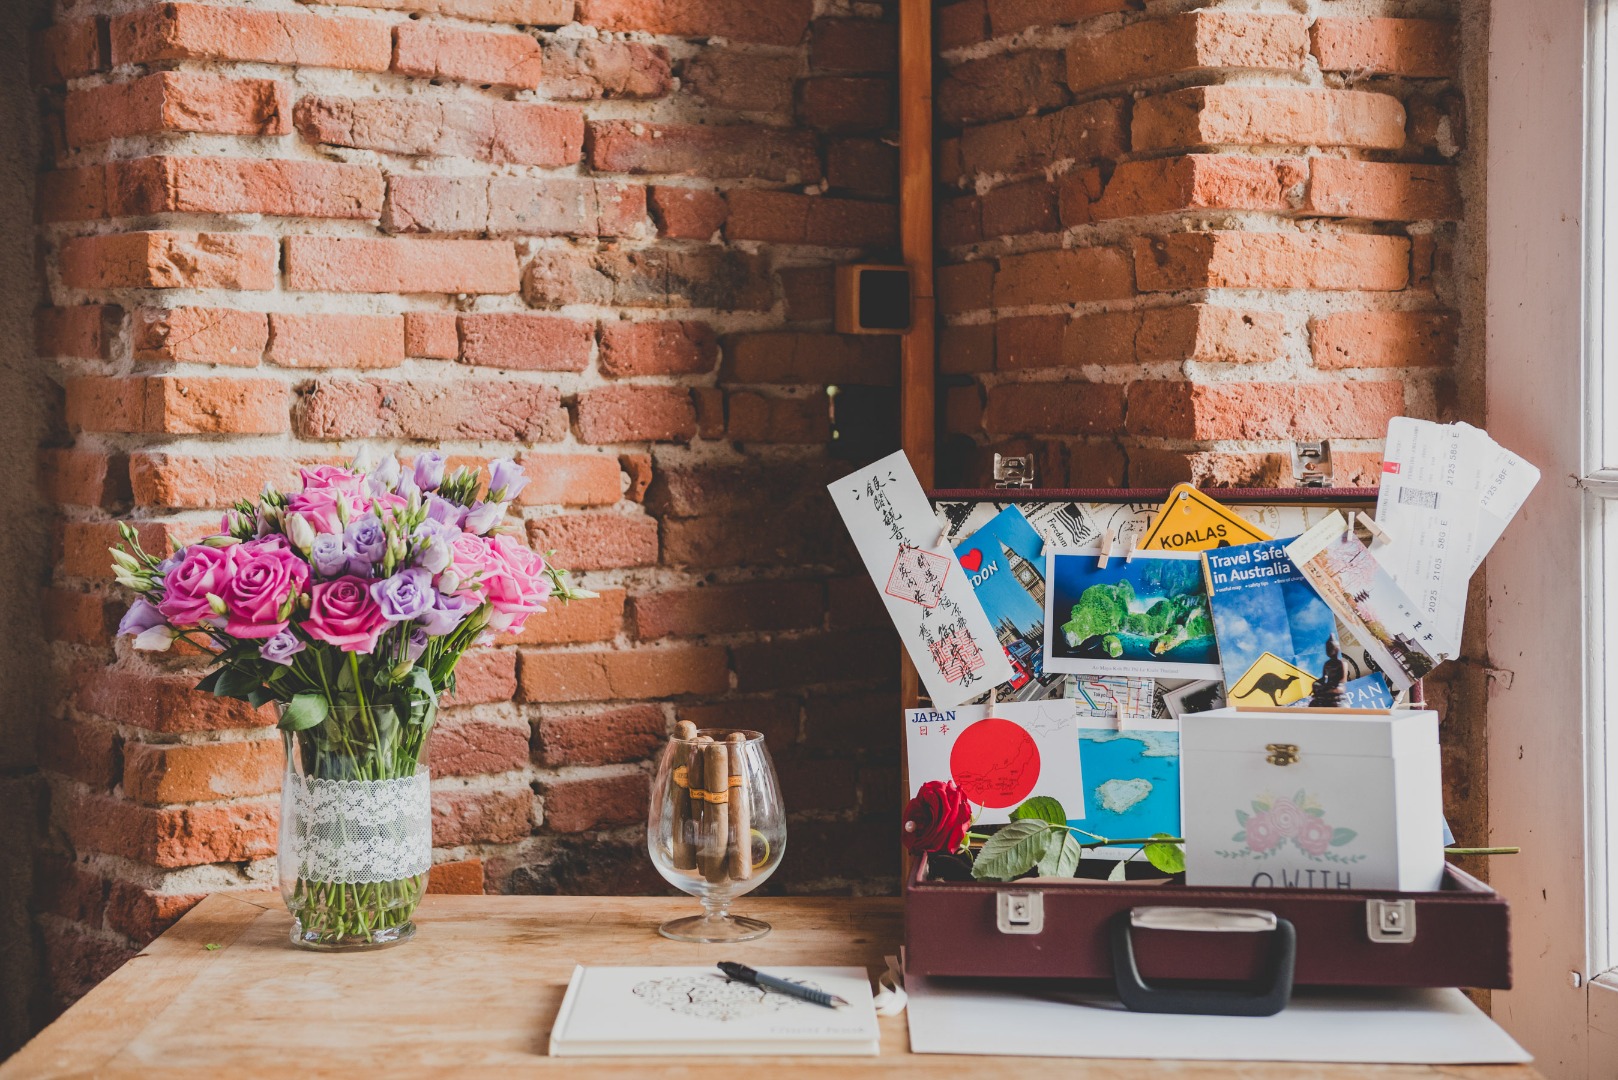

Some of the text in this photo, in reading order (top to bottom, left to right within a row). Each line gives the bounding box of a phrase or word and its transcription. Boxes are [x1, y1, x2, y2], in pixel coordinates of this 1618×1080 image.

[1047, 518, 1068, 548] Freedom
[1160, 524, 1227, 550] KOALAS
[1209, 545, 1291, 568] Travel Safel
[1213, 562, 1291, 584] in Australia
[911, 710, 956, 723] JAPAN
[919, 723, 950, 736] 日本
